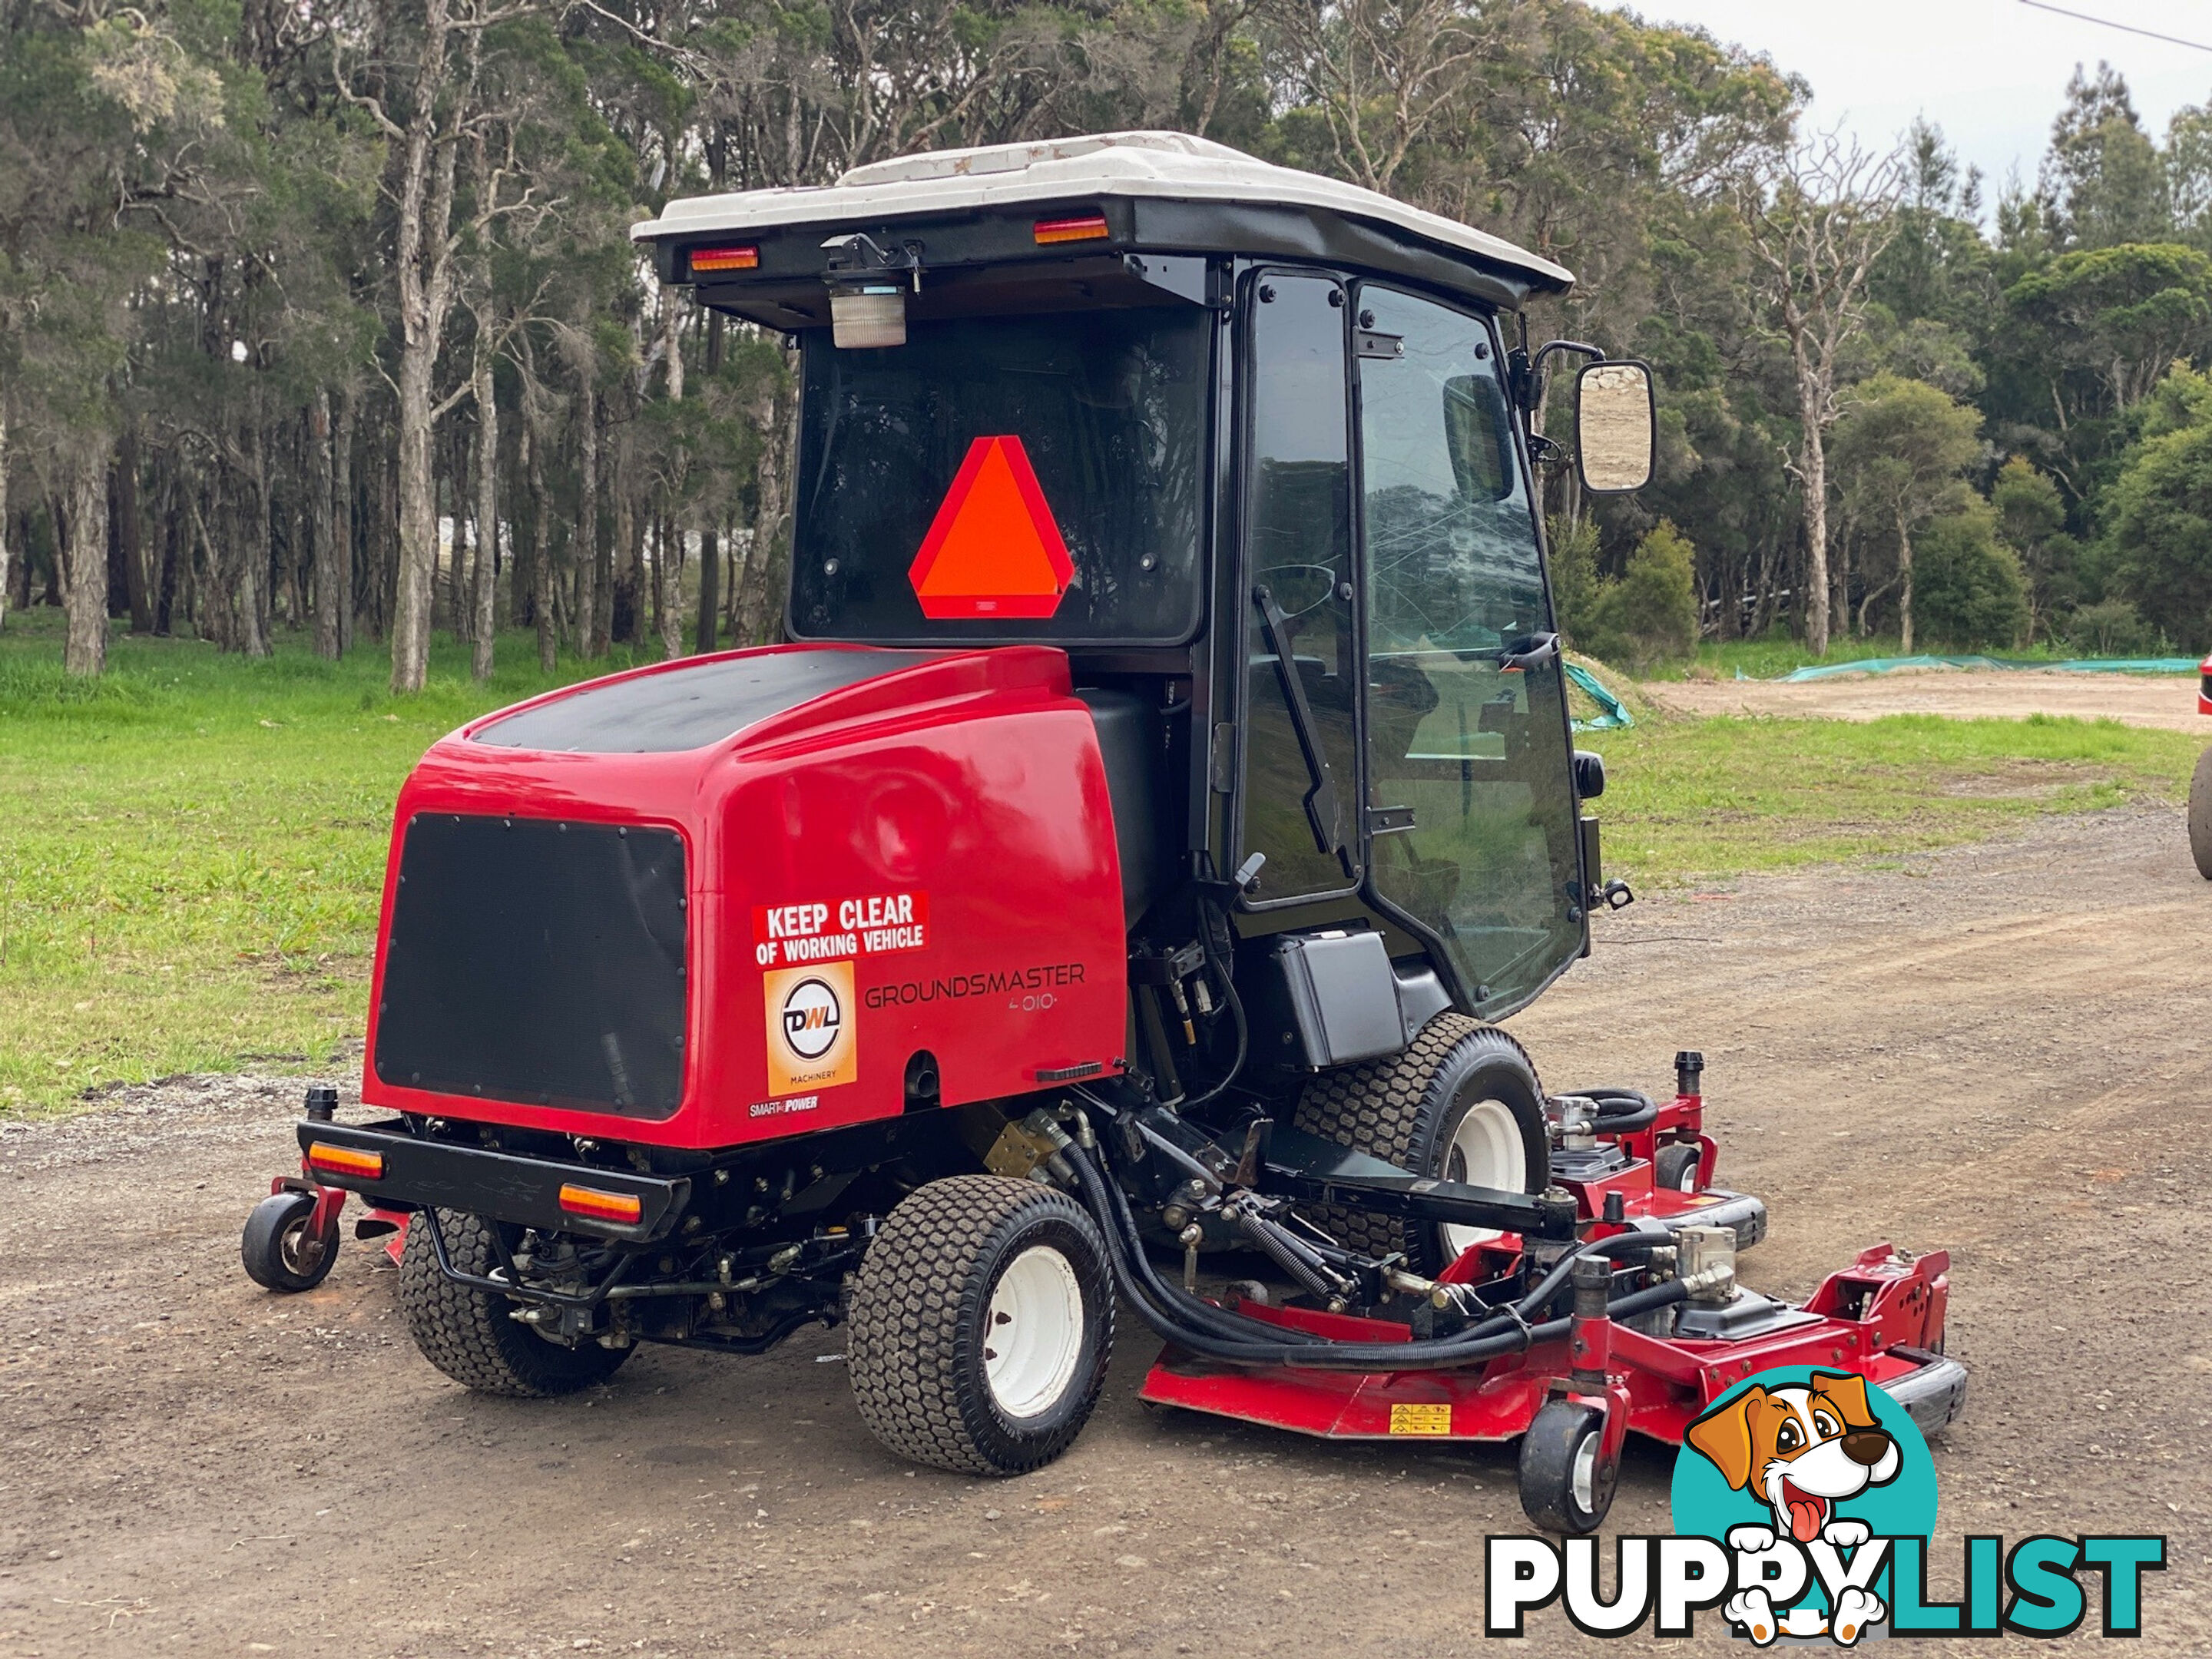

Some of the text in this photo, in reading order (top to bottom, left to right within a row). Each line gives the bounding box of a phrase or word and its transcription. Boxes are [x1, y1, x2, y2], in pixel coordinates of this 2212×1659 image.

[767, 894, 913, 939] KEEP CLEAR
[756, 925, 923, 965] OF WORKING VEHICLE
[865, 963, 1085, 1008] GROUNDSMASTER
[790, 1070, 836, 1085] MACHINERY
[784, 1095, 818, 1112] POWER
